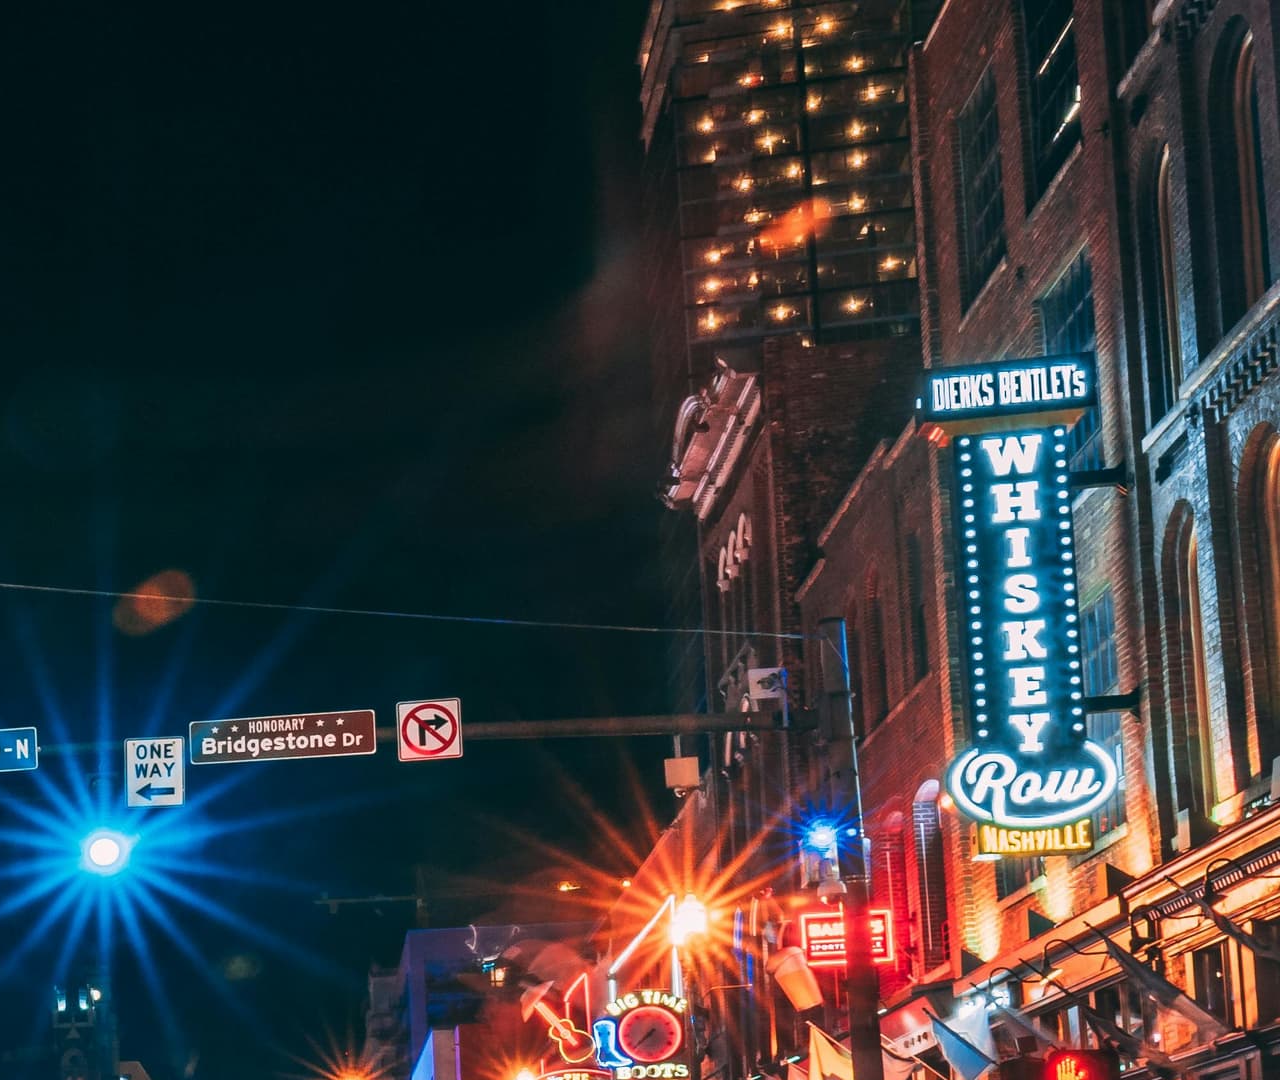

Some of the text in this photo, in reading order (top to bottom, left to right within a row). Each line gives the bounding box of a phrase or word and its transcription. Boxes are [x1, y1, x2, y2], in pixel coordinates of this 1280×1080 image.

[932, 373, 995, 412] DIERKS
[982, 433, 1051, 753] WHISKEY
[248, 718, 306, 733] HONORARY
[135, 743, 174, 760] ONE
[201, 731, 364, 758] Bridgestone Dr
[134, 762, 176, 779] WAY
[966, 753, 1102, 814] Row
[983, 819, 1092, 853] NASHVILLE
[607, 990, 688, 1017] BIG TIME
[617, 1063, 689, 1080] BOOTS
